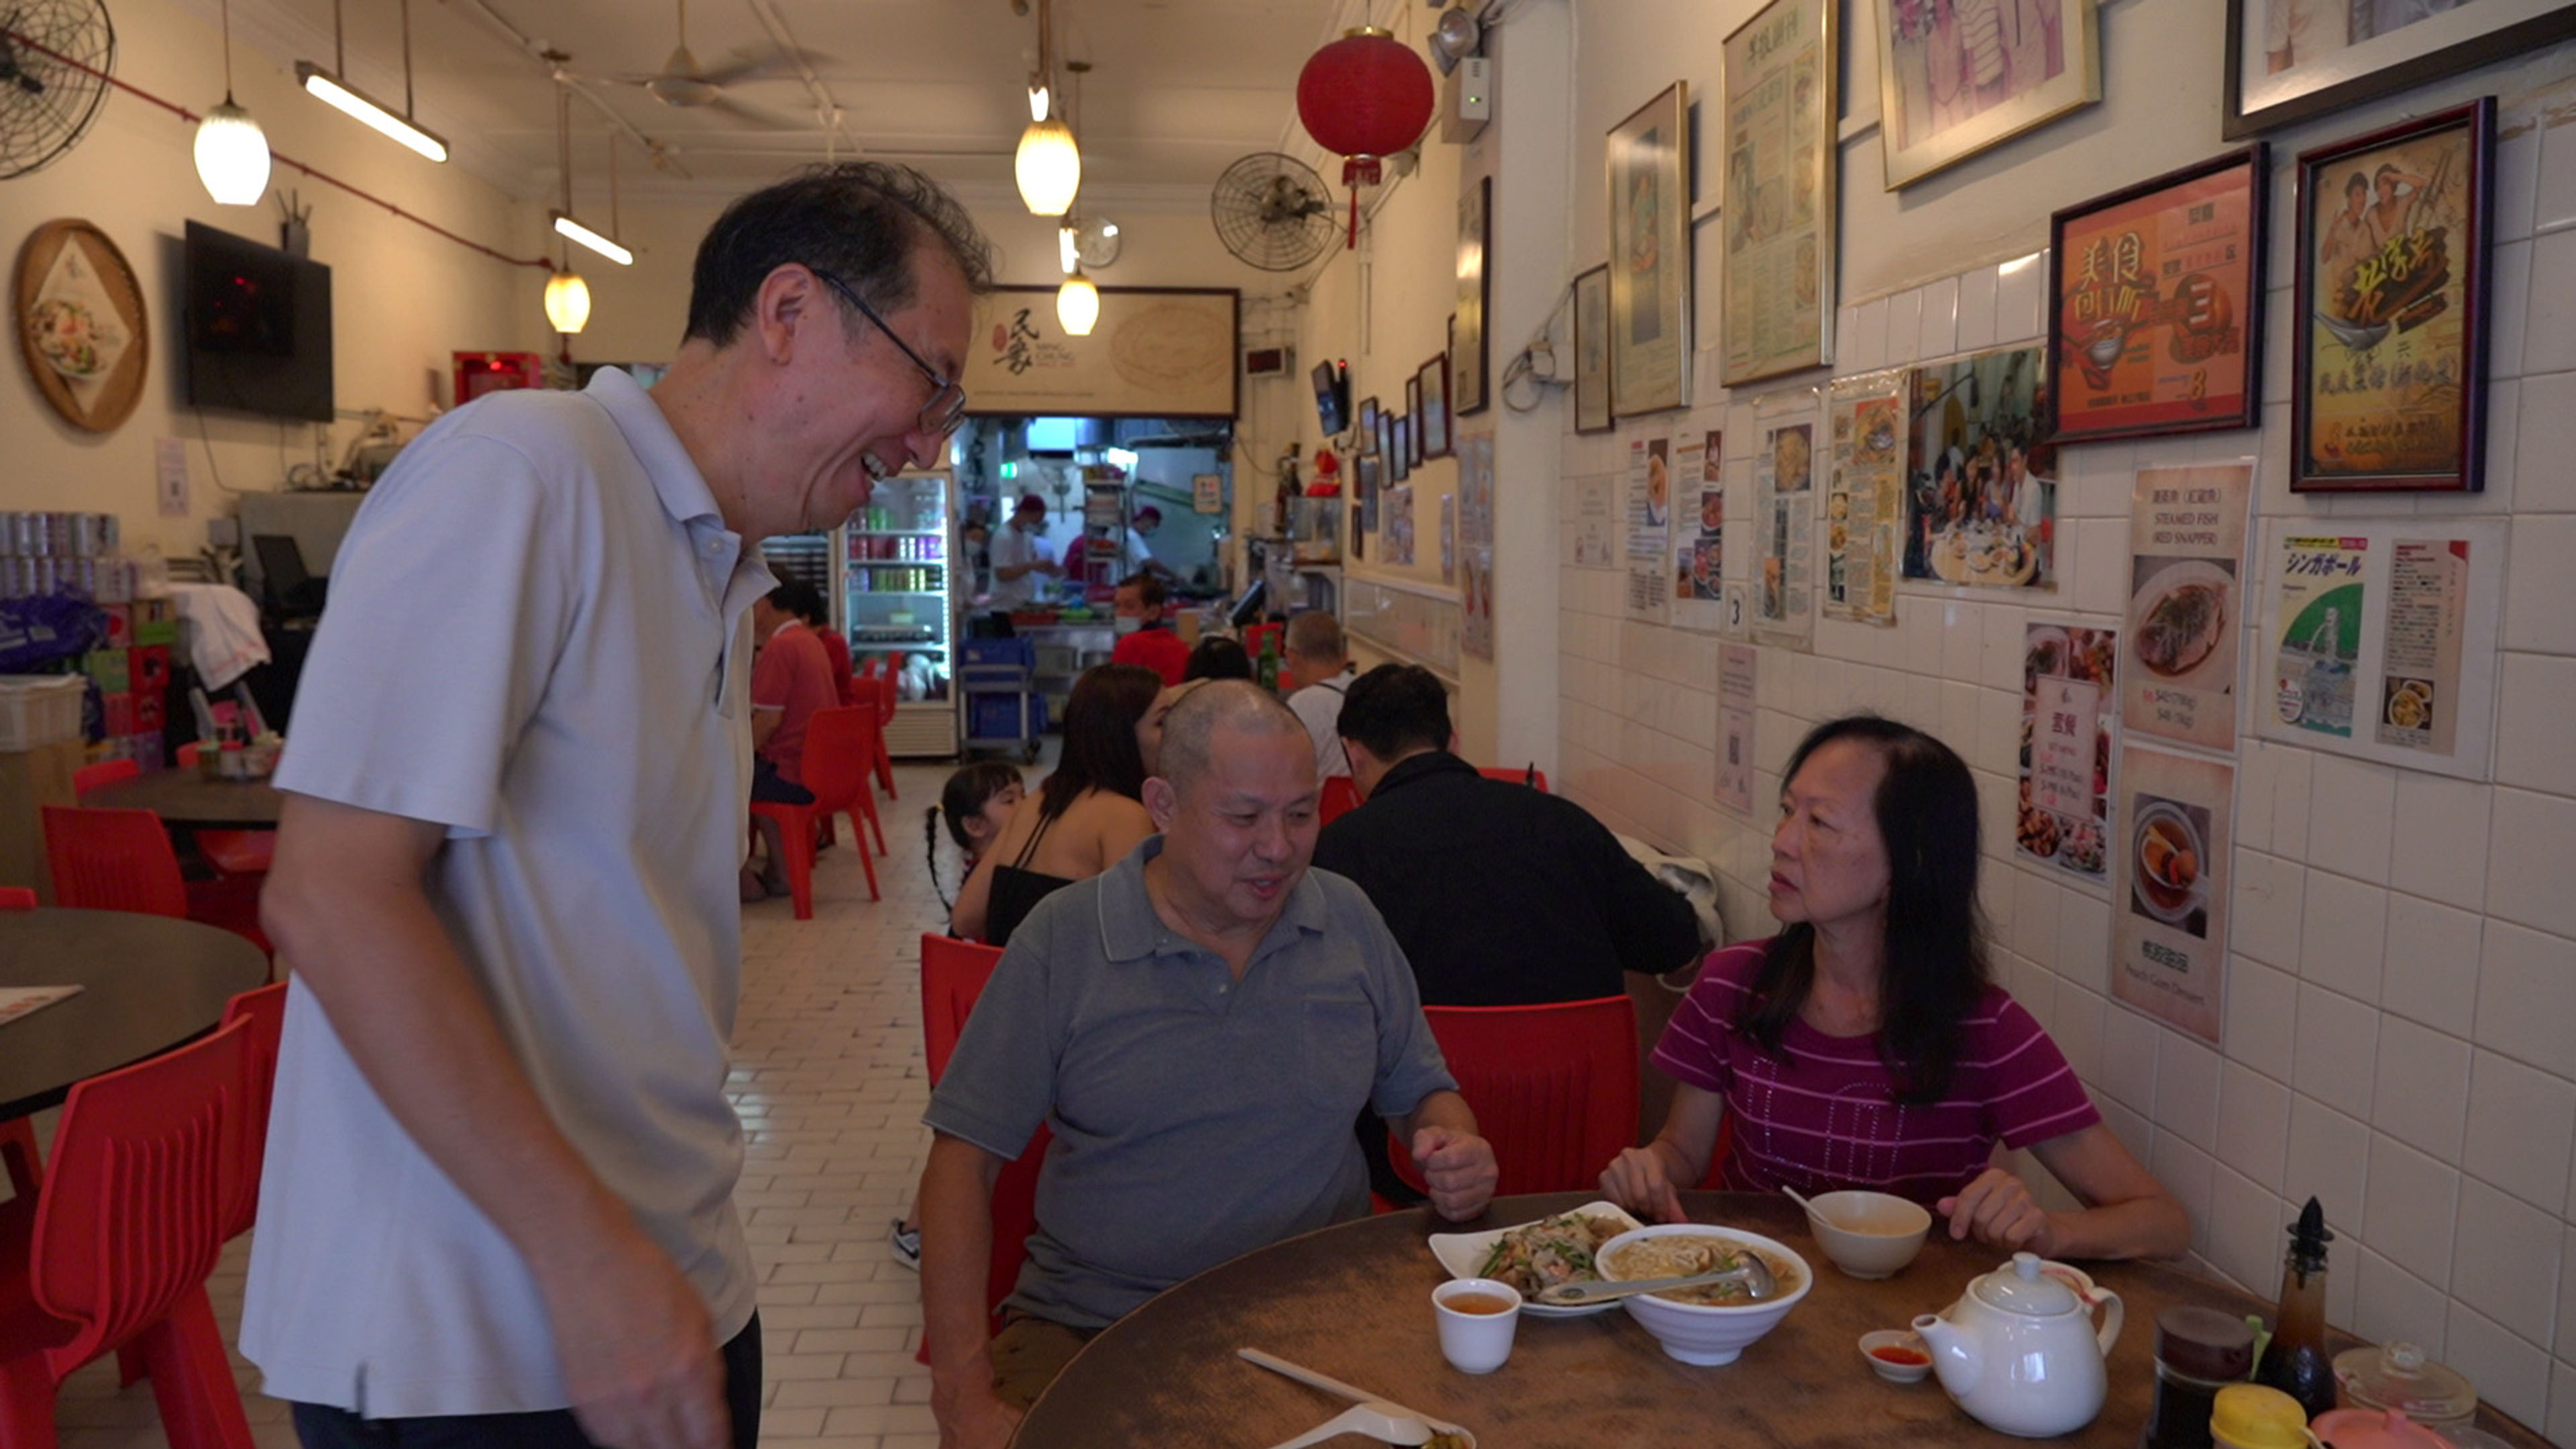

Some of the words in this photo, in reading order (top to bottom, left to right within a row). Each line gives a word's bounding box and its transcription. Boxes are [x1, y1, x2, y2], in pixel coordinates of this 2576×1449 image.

[2154, 513, 2196, 525] STEAMED
[2197, 513, 2219, 525] FISH
[2152, 531, 2173, 544] (RED
[2174, 531, 2218, 546] SNAPPER)
[1731, 598, 1740, 625] 3
